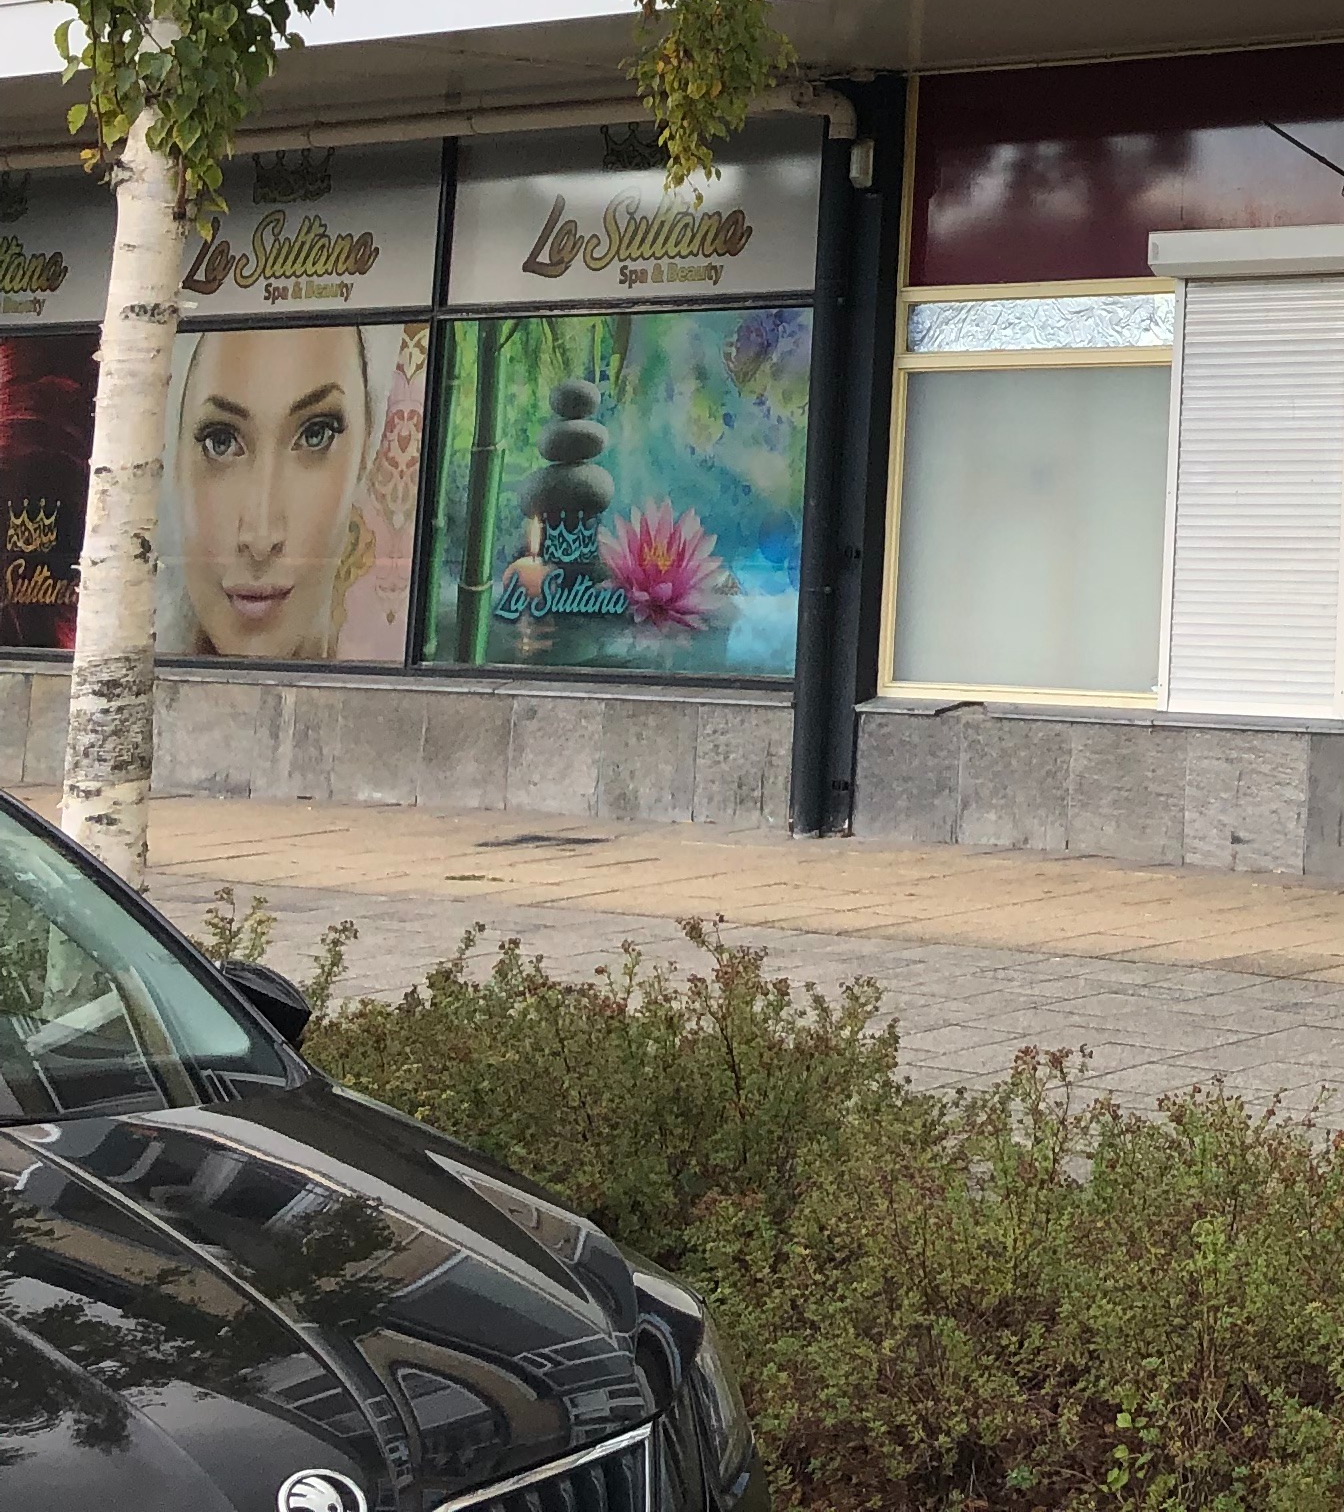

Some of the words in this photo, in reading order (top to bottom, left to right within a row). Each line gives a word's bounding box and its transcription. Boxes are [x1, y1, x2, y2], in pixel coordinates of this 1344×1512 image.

[182, 216, 237, 295] La
[234, 209, 380, 289] Sultana
[522, 193, 584, 279] La
[583, 185, 753, 272] Sultana
[264, 283, 289, 304] Spa
[291, 278, 303, 300] &
[305, 281, 354, 302] Beauty
[619, 264, 648, 288] Spa
[650, 262, 664, 284] &
[666, 261, 724, 286] Beauty
[494, 570, 530, 619] La
[530, 568, 629, 617] Sultana
